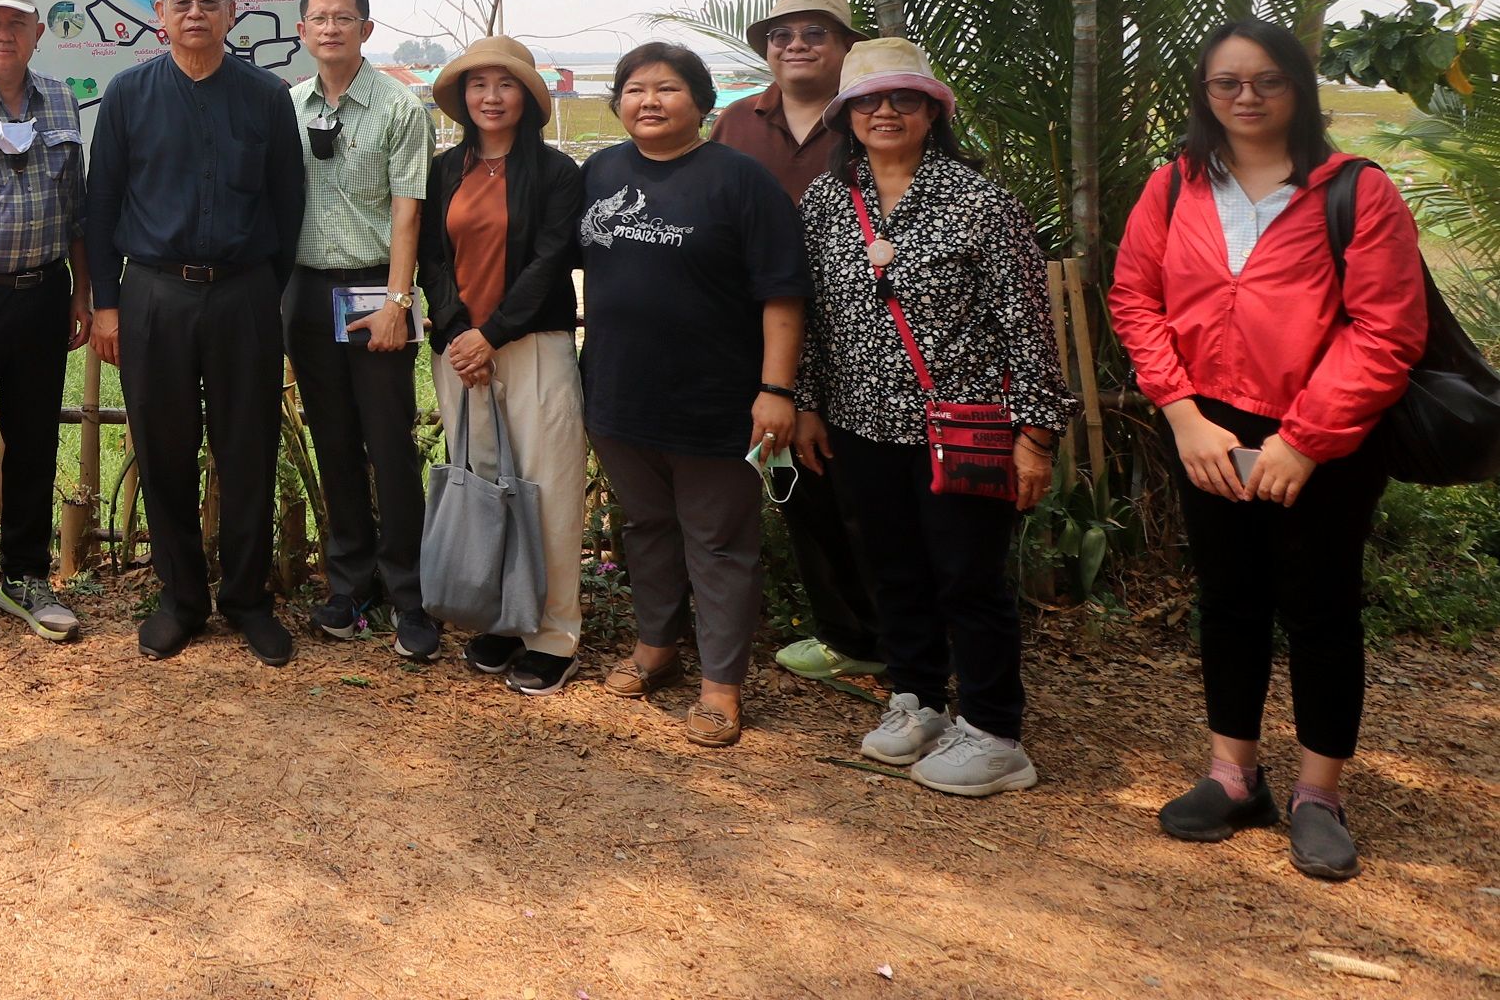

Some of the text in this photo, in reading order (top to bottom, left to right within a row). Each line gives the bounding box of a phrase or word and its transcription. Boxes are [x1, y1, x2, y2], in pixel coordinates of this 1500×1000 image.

[613, 224, 683, 247] หอมนาคา
[929, 411, 952, 419] SAVE
